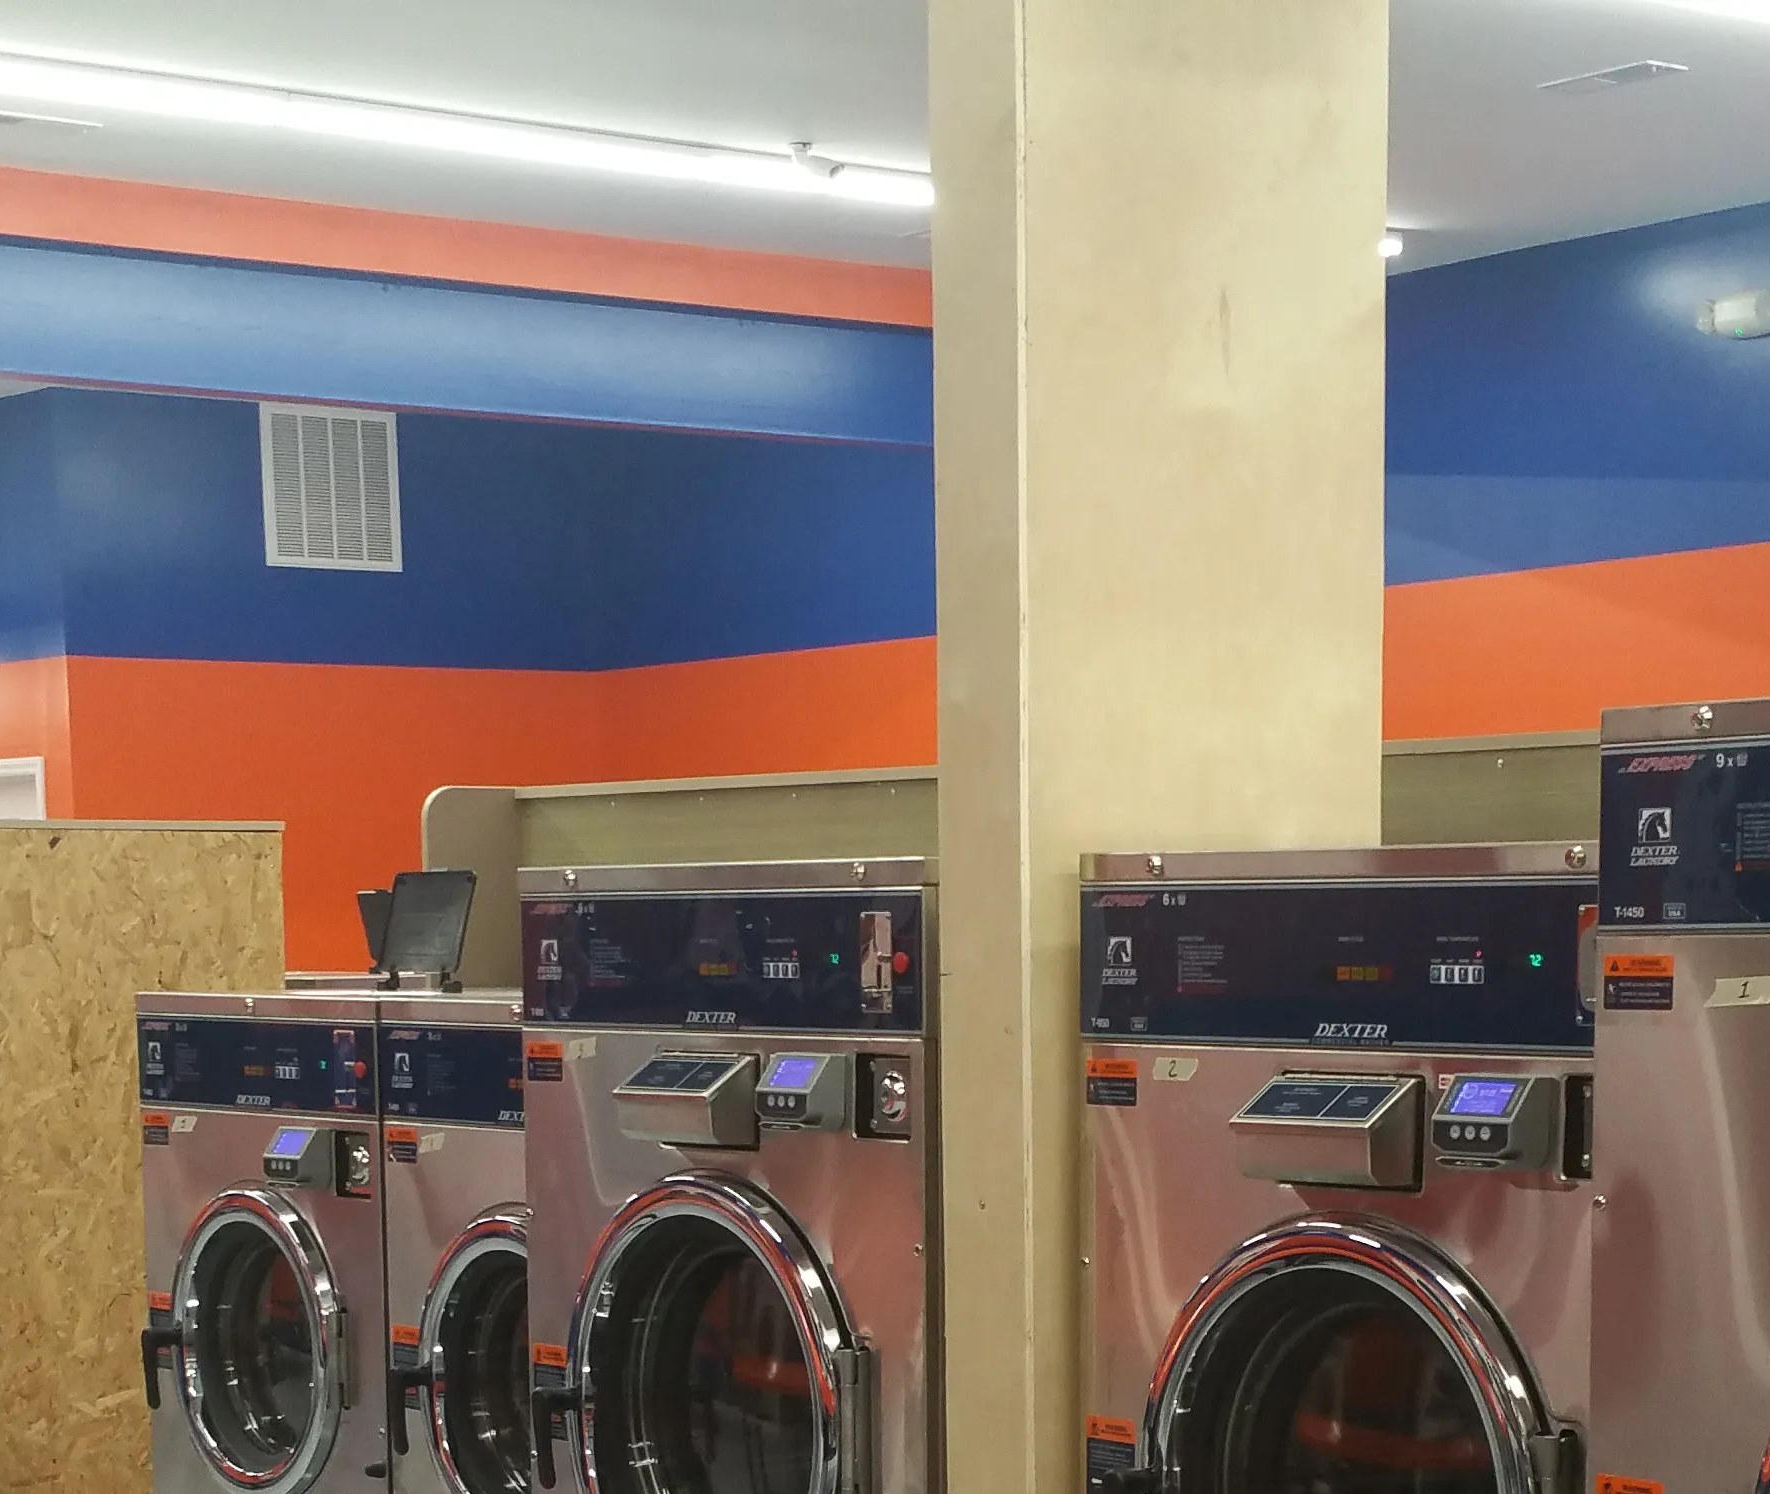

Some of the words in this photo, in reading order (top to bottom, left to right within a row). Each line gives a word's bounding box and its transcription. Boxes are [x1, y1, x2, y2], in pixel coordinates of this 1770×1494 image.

[1631, 845, 1678, 857] DEXTER
[1614, 906, 1645, 918] T-1450
[1738, 980, 1750, 999] 1
[685, 1011, 737, 1025] DEXTER
[1314, 1022, 1388, 1039] DEXTER
[1168, 1059, 1178, 1078] 2
